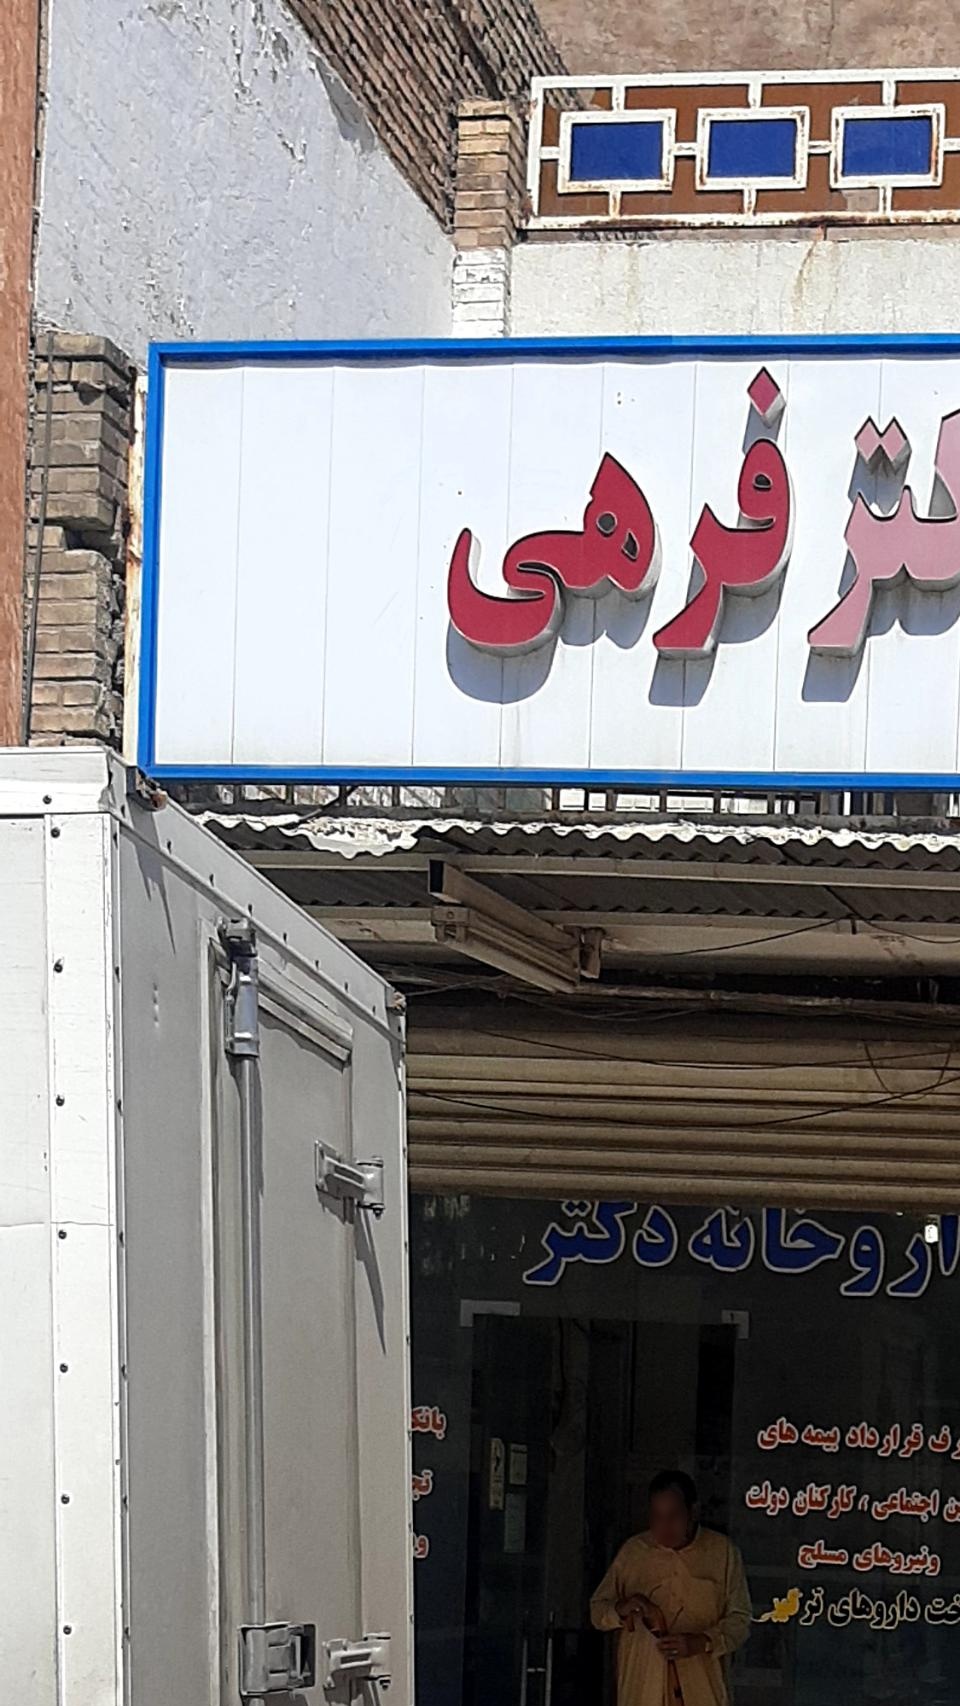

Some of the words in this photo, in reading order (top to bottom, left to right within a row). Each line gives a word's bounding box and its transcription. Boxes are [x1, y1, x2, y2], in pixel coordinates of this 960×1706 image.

[446, 366, 790, 656] فرهی
[757, 1416, 799, 1450] های
[801, 1424, 841, 1452] بیمه
[846, 1421, 924, 1457] قرارداد
[746, 1480, 789, 1516] دولت
[793, 1482, 857, 1518] کارکنان
[871, 1486, 940, 1522] اجتماعی
[798, 1539, 849, 1570] مسلح
[827, 1586, 922, 1630] داروهای
